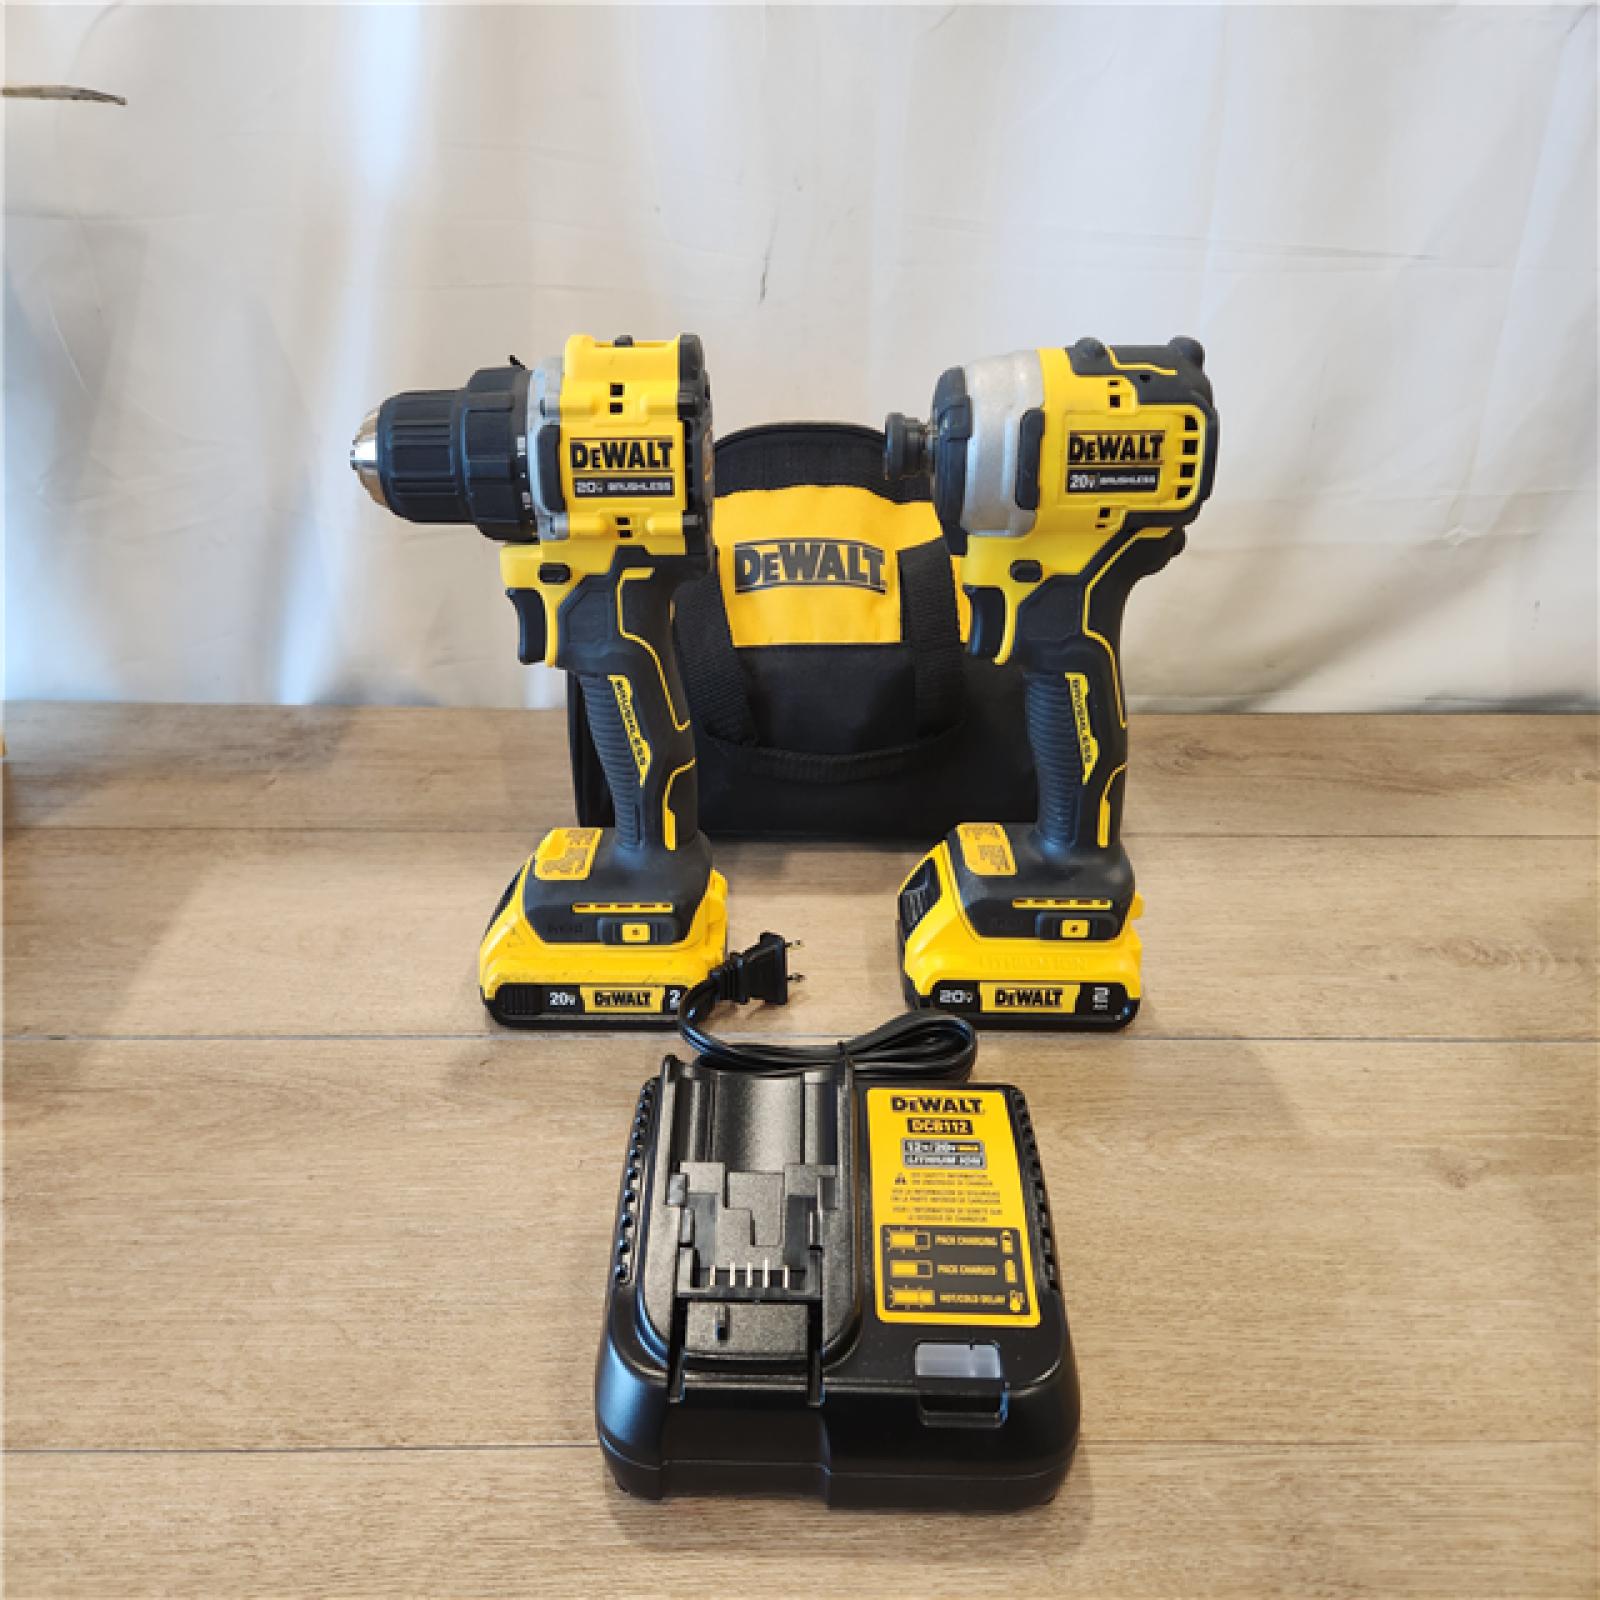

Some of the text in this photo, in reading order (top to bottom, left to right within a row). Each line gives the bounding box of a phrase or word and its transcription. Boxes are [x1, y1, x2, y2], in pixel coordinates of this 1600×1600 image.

[571, 441, 673, 469] DEWALT
[1068, 434, 1163, 461] DEWALT
[607, 481, 671, 492] BRUSHLESS
[735, 541, 885, 592] DEWALT
[614, 680, 647, 766] BRUSHLESS
[594, 990, 652, 1006] DEWALT
[994, 987, 1063, 1007] DEWALT
[892, 1096, 983, 1113] DEWALT
[911, 1118, 969, 1133] DCB112
[935, 1235, 998, 1247] PACK CHARGING
[937, 1264, 997, 1276] PACK CHARGED
